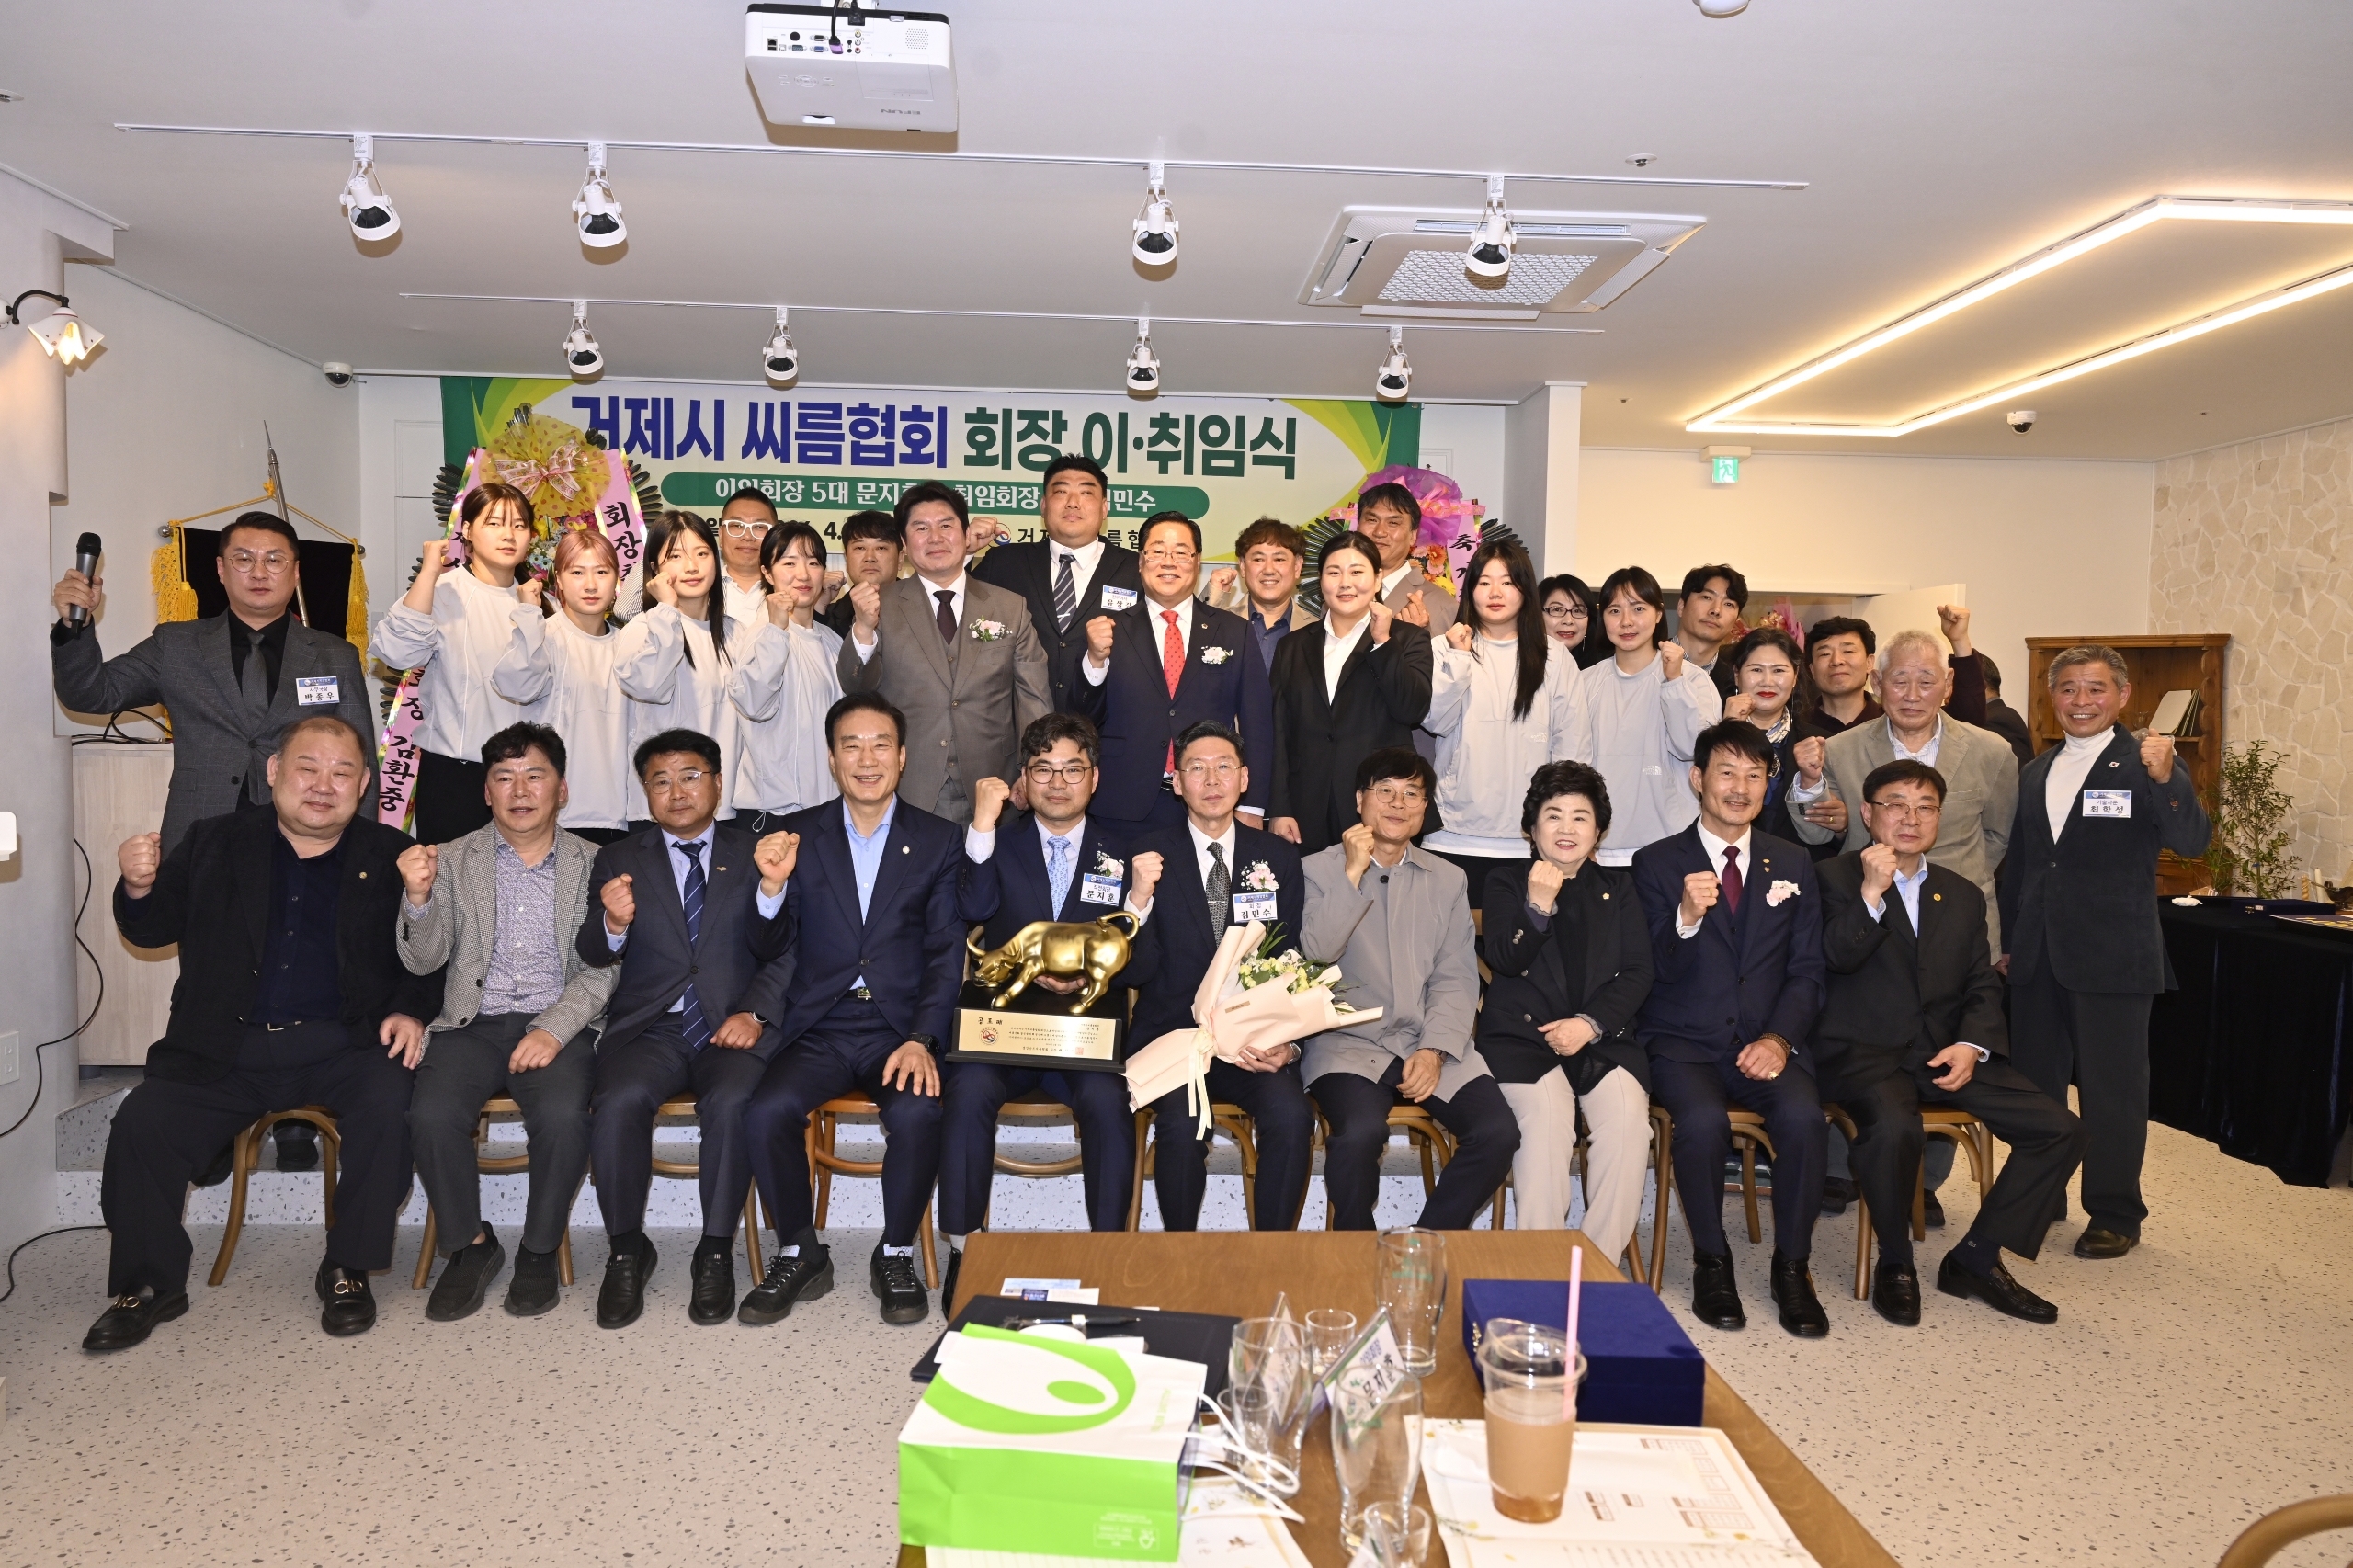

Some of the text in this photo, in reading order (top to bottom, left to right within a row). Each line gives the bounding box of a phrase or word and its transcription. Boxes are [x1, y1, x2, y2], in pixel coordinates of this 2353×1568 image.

[571, 395, 1298, 480] 거제시 씨름협회 회장 이·취임식
[812, 481, 849, 505] 5대
